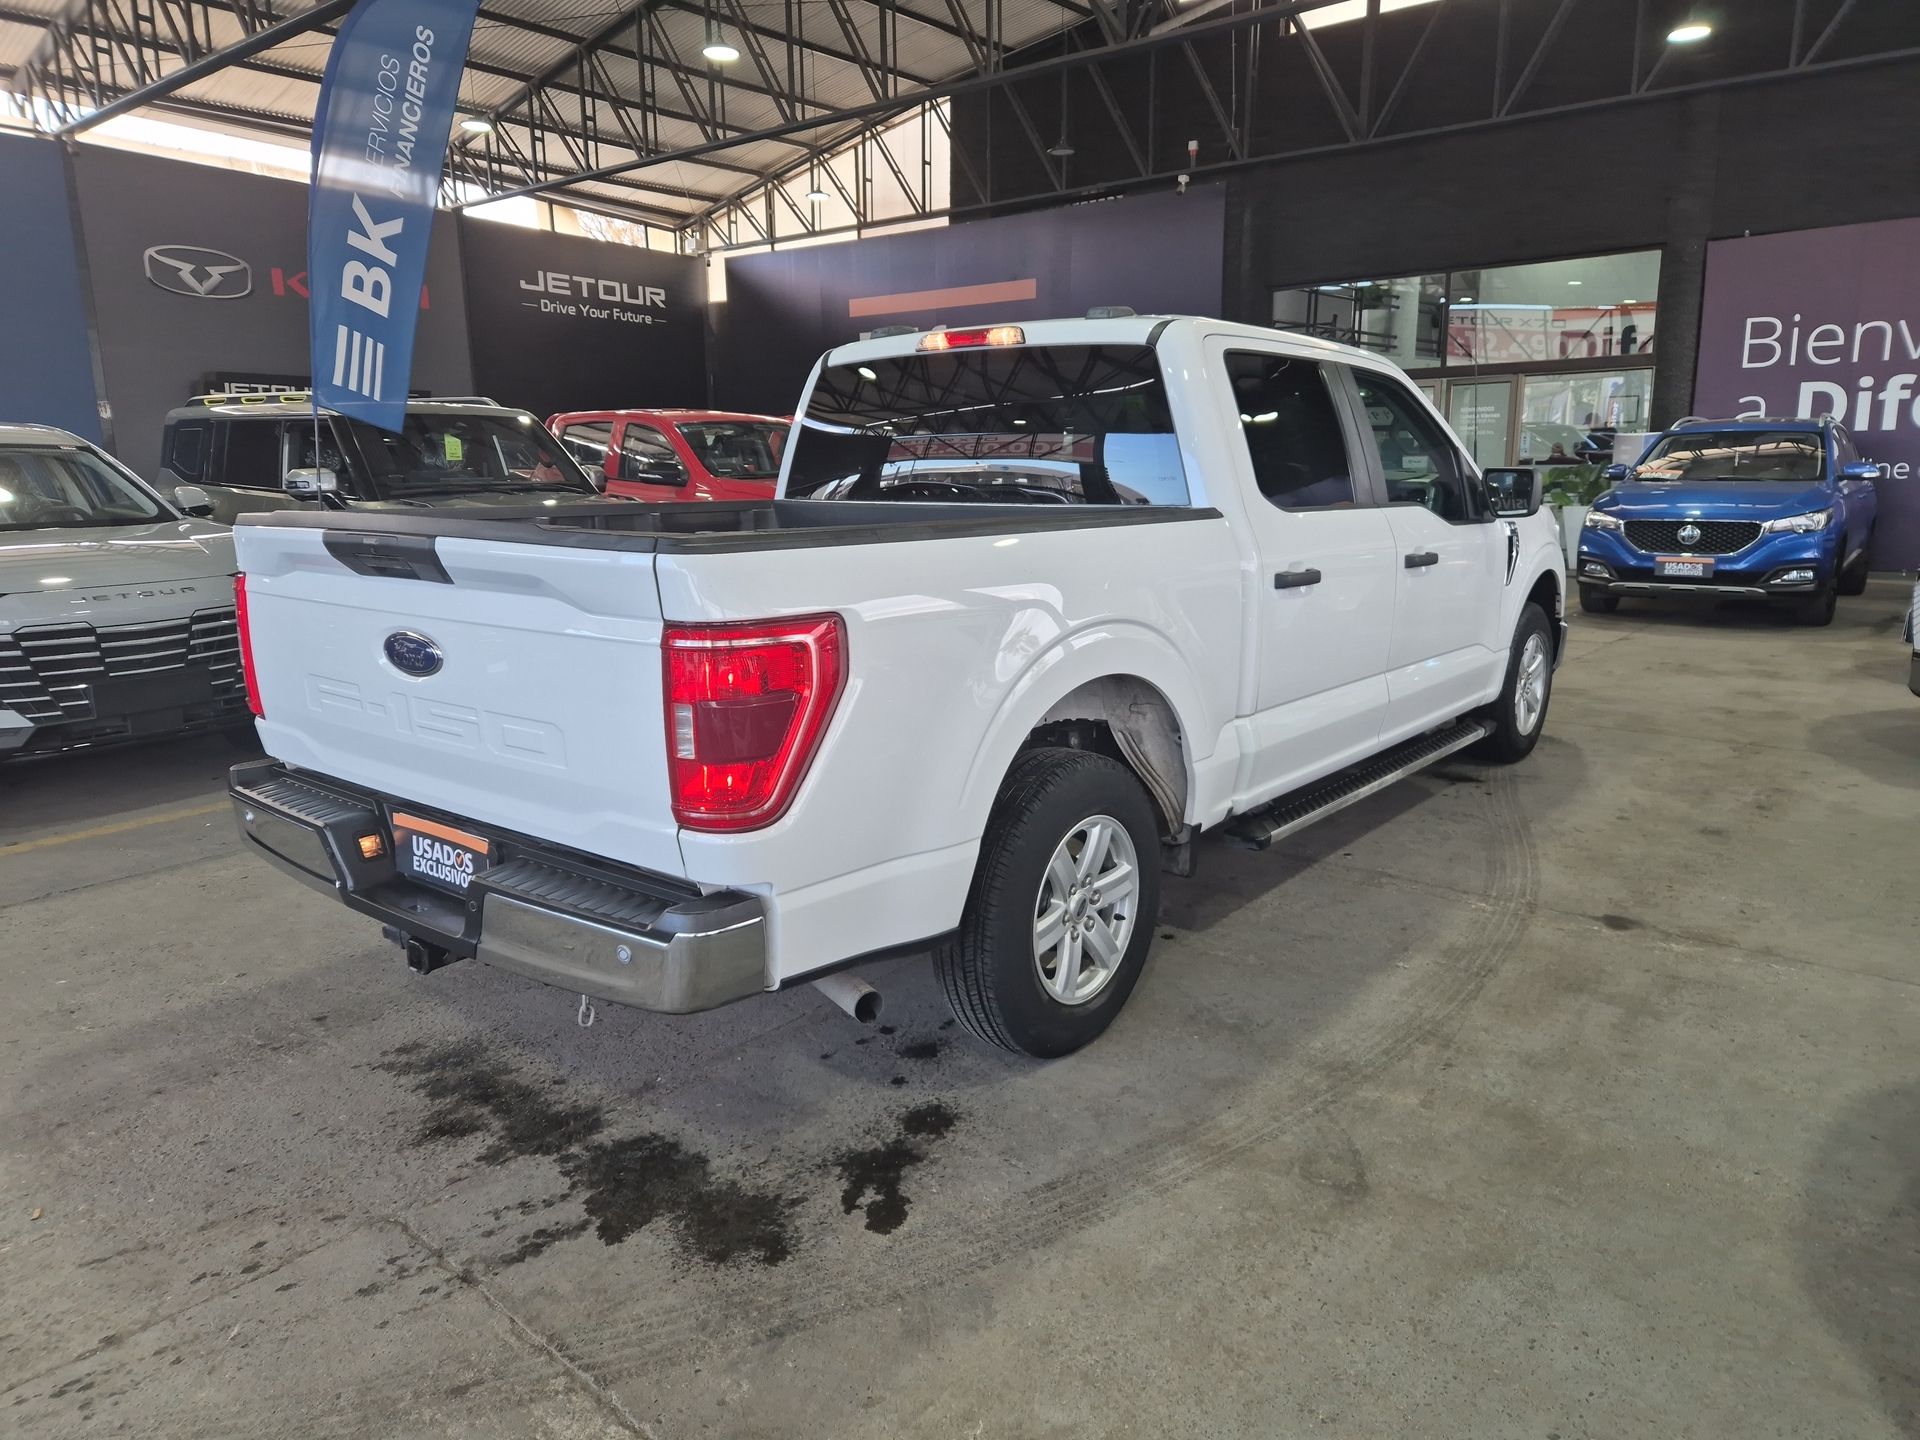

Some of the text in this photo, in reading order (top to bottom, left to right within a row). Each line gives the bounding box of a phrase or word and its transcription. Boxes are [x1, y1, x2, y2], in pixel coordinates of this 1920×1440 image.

[341, 192, 403, 318] BK
[520, 271, 666, 308] JETOUR
[541, 299, 652, 324] Drive Your Future
[1664, 562, 1703, 570] USADOS
[70, 586, 196, 603] JETOUR
[304, 673, 568, 769] F-150
[412, 835, 474, 874] USADOS
